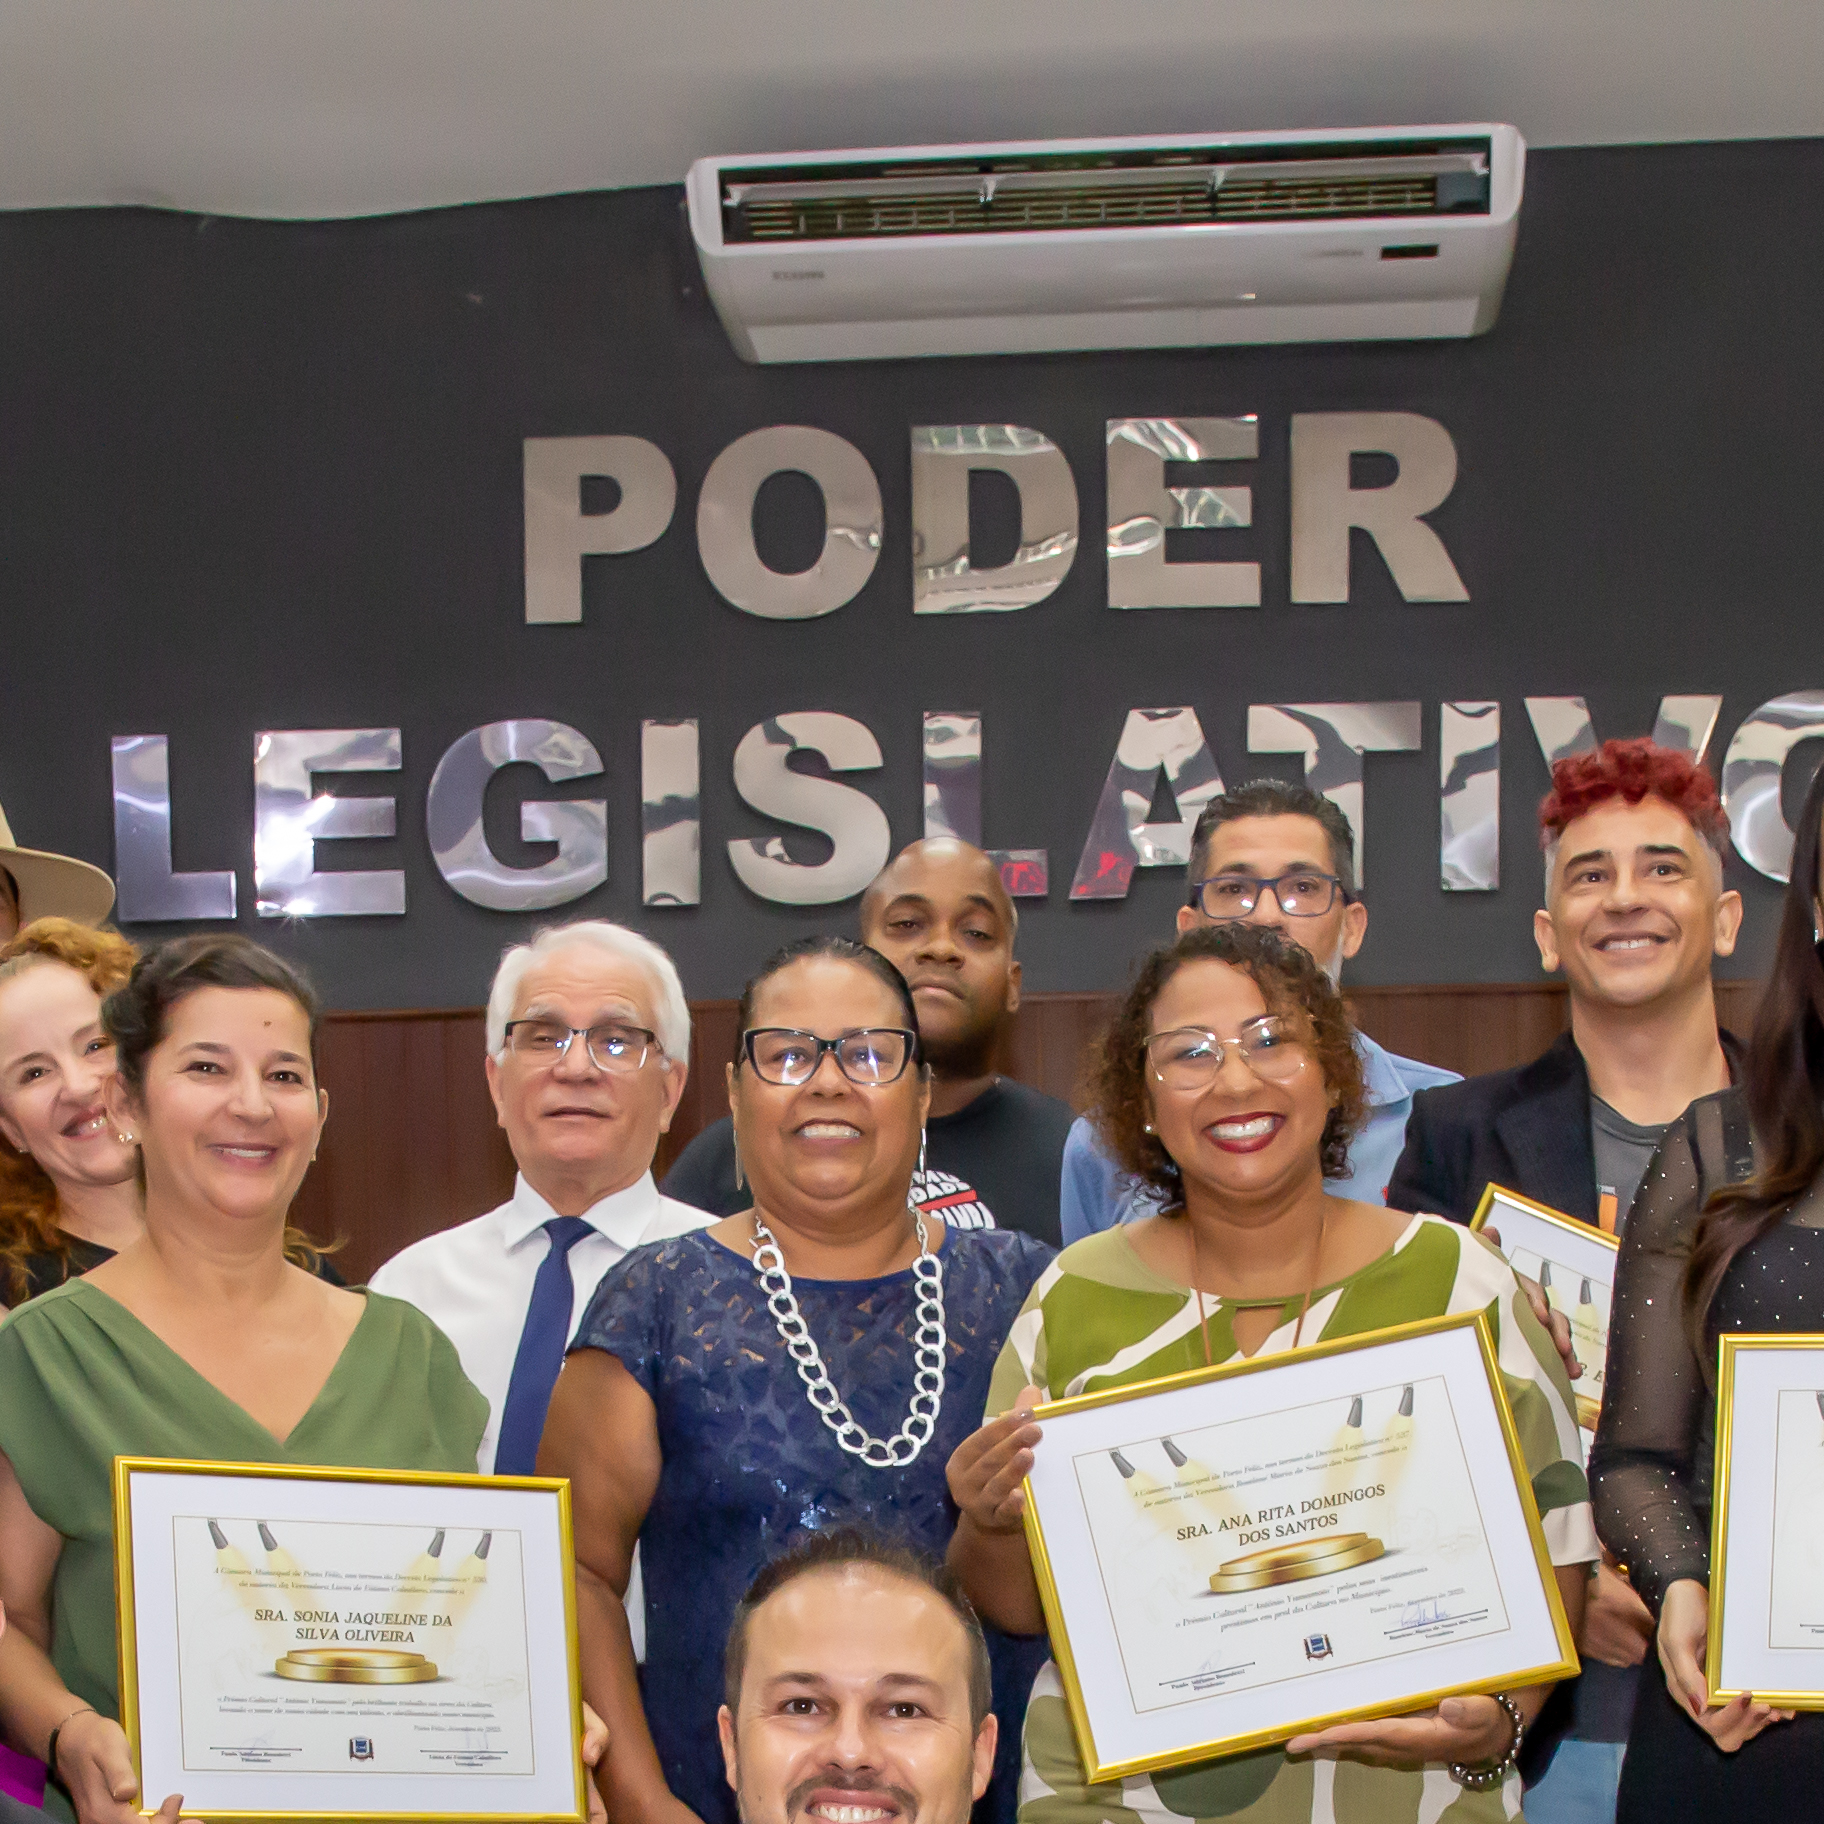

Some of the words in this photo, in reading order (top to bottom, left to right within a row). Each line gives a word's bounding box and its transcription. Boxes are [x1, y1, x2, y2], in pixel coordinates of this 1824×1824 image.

[523, 411, 1470, 625] PODER
[1177, 1524, 1212, 1540] SRA.
[1218, 1514, 1252, 1532] ANA
[1258, 1504, 1295, 1523] RITA
[1301, 1484, 1385, 1513] DOMINGOS
[1239, 1528, 1270, 1546] DOS
[1276, 1513, 1338, 1537] SANTOS
[255, 1609, 288, 1621] SRA.
[294, 1611, 339, 1623] SONIA
[344, 1612, 427, 1626] JAQUELINE
[432, 1615, 452, 1626] DA
[296, 1628, 339, 1640] SILVA
[345, 1629, 414, 1642] OLIVEIRA
